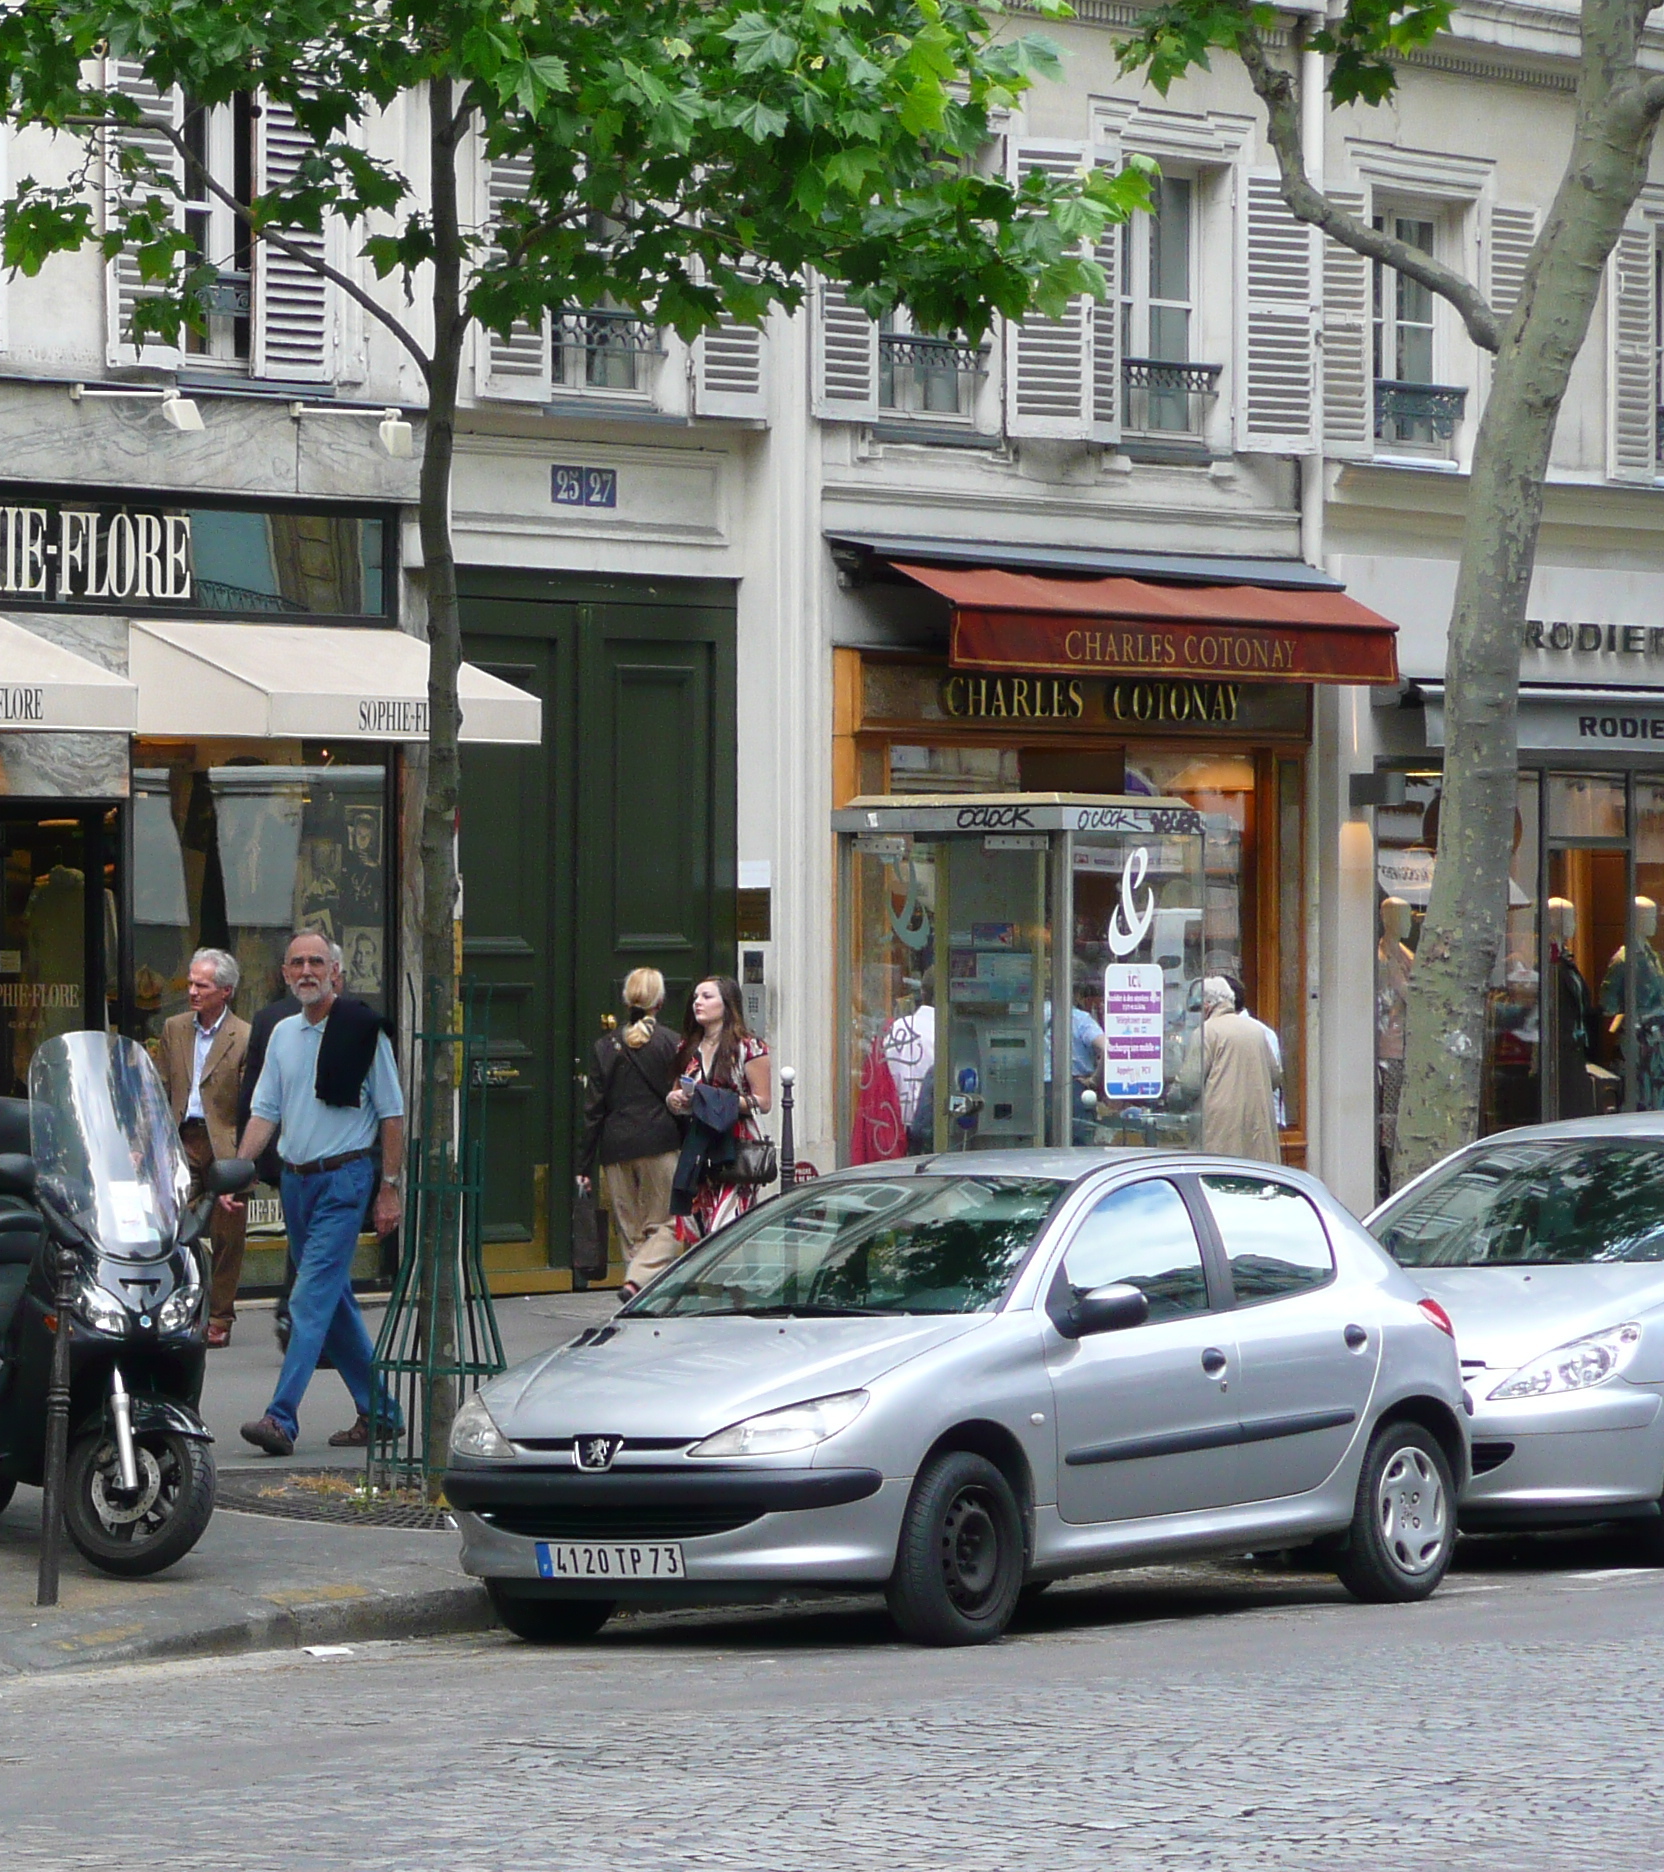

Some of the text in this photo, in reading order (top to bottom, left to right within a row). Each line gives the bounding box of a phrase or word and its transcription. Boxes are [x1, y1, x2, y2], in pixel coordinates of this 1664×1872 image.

[557, 470, 580, 500] 25
[589, 473, 613, 502] 27
[1065, 630, 1298, 669] CHARLES COTONAY
[945, 676, 1239, 721] CHARLES COTONAY
[556, 1547, 610, 1575] 4120
[615, 1547, 642, 1575] TP
[648, 1547, 678, 1575] 73
